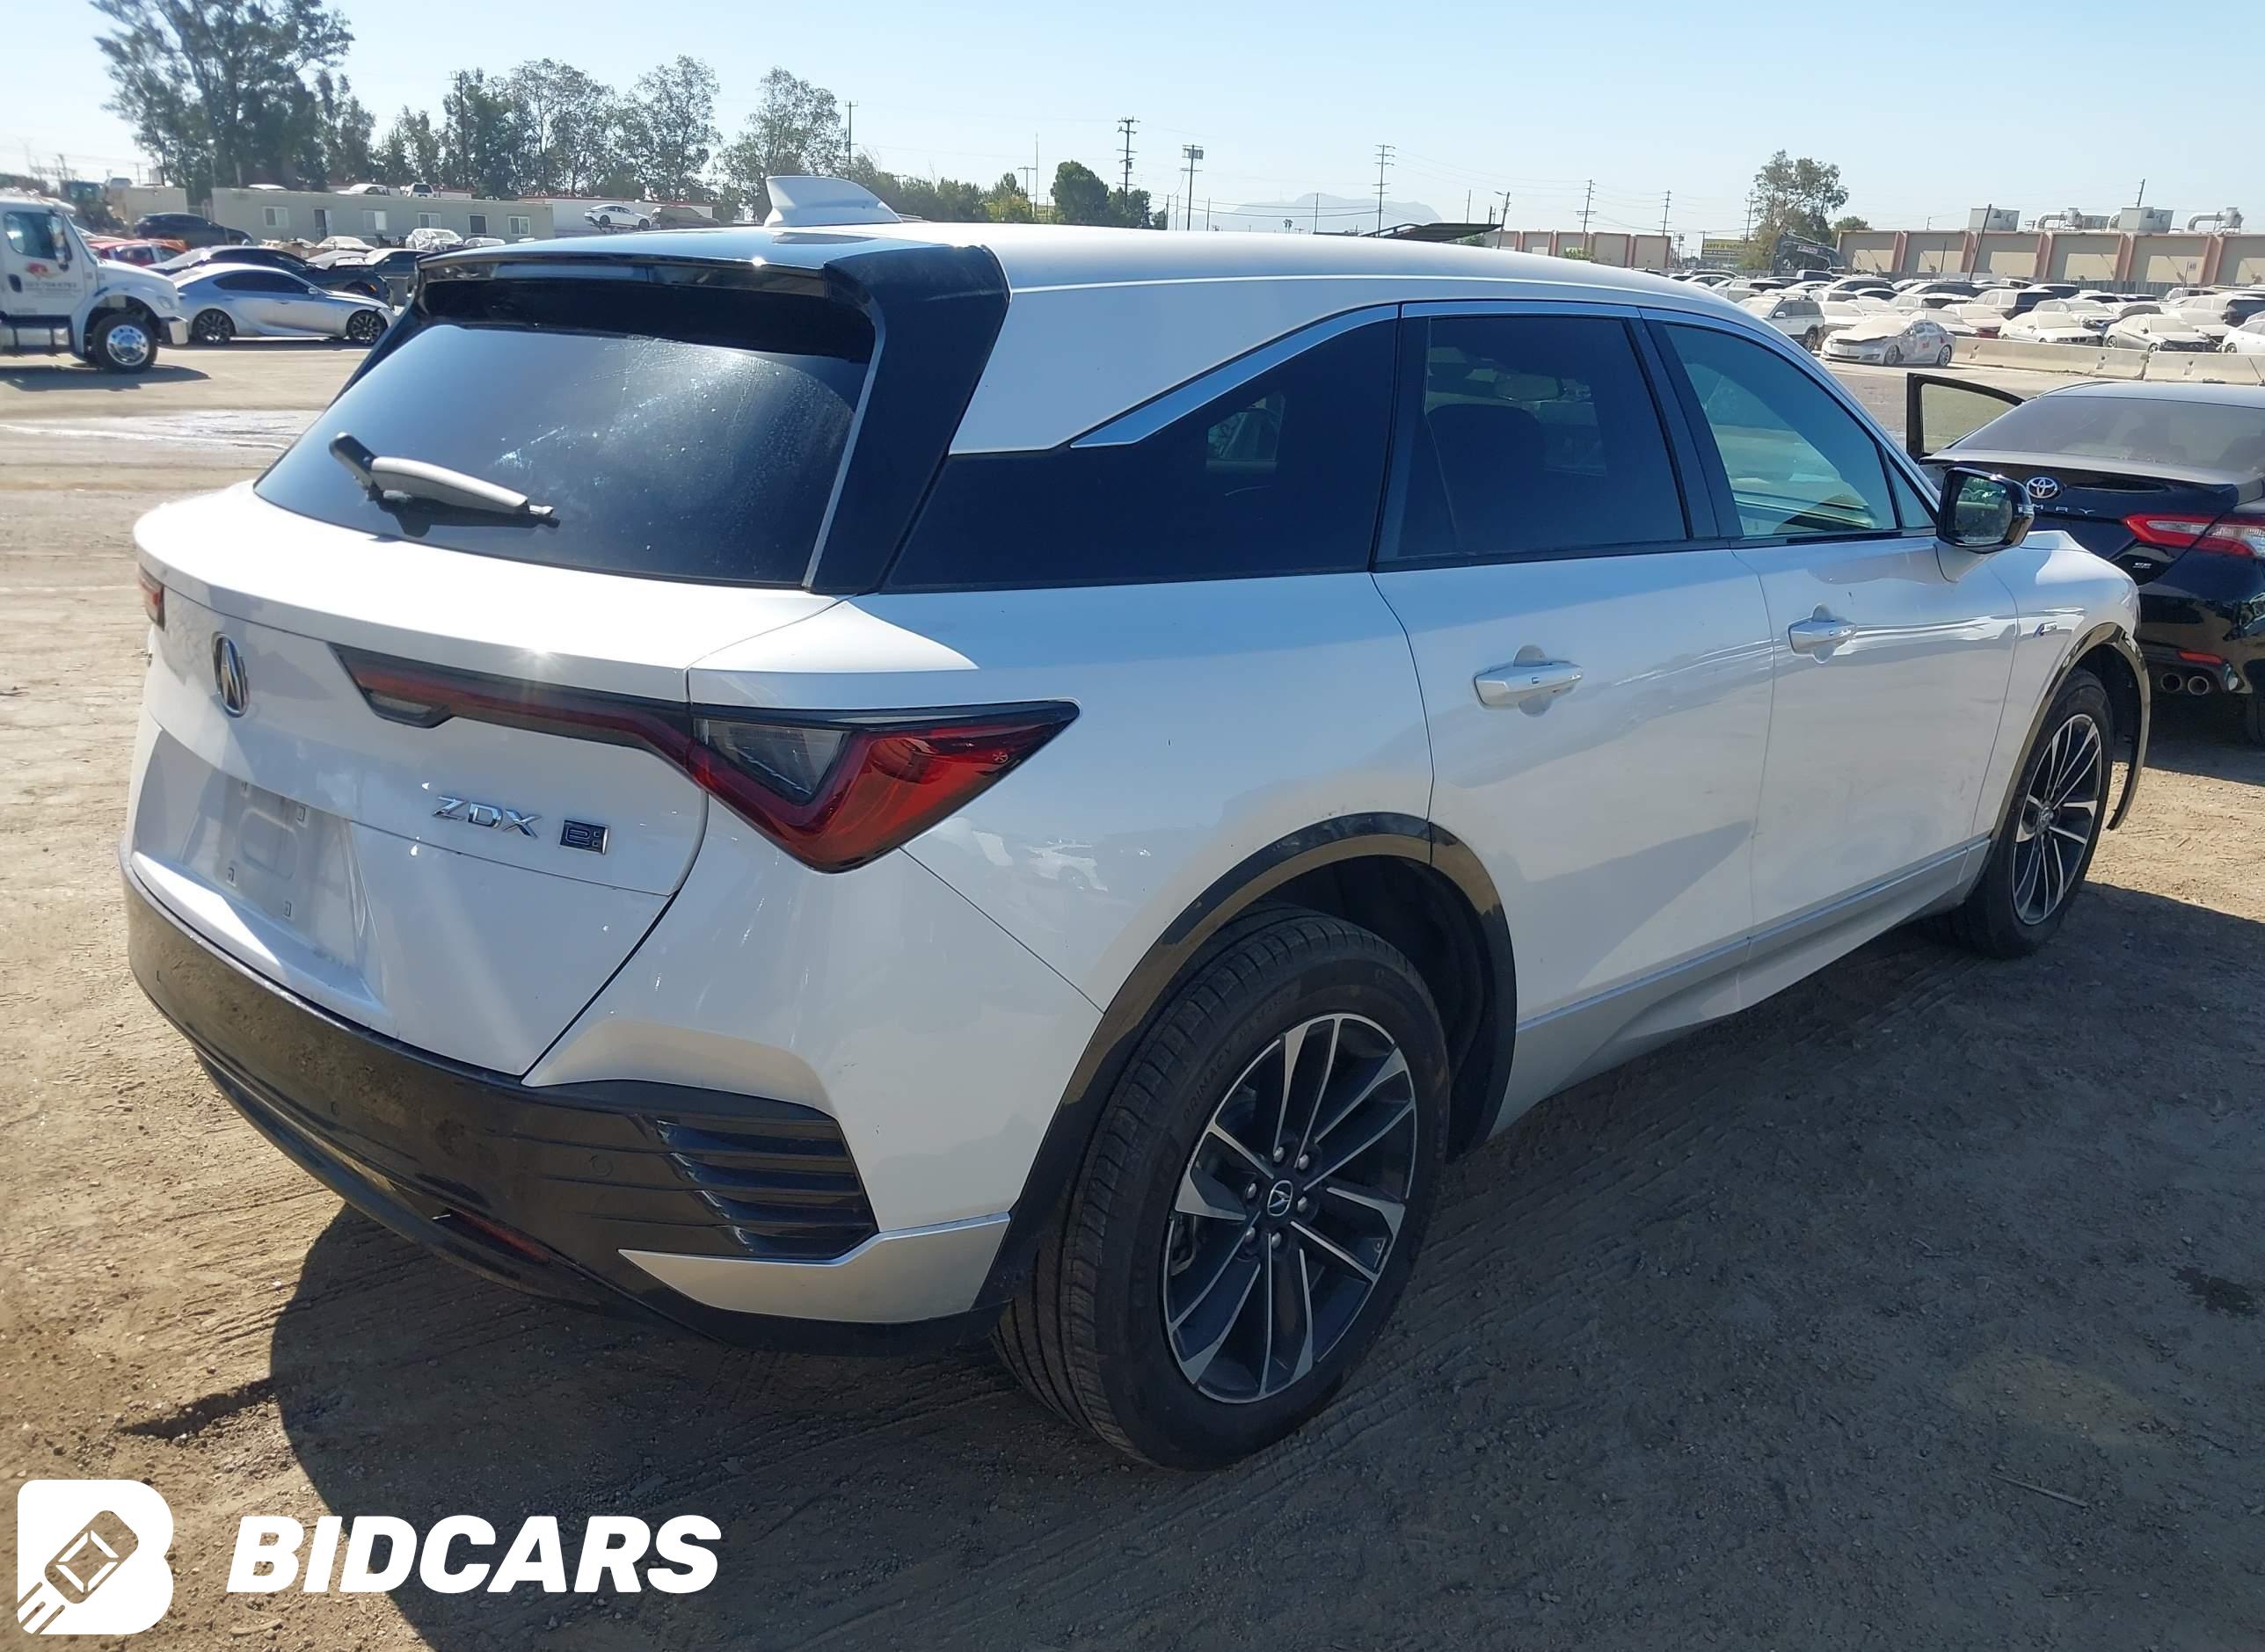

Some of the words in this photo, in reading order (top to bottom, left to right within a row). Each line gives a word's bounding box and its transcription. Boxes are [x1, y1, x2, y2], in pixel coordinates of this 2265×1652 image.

[2032, 504, 2095, 514] MRY
[432, 796, 543, 838] ZDX
[1183, 1043, 1232, 1122] PRIMACY
